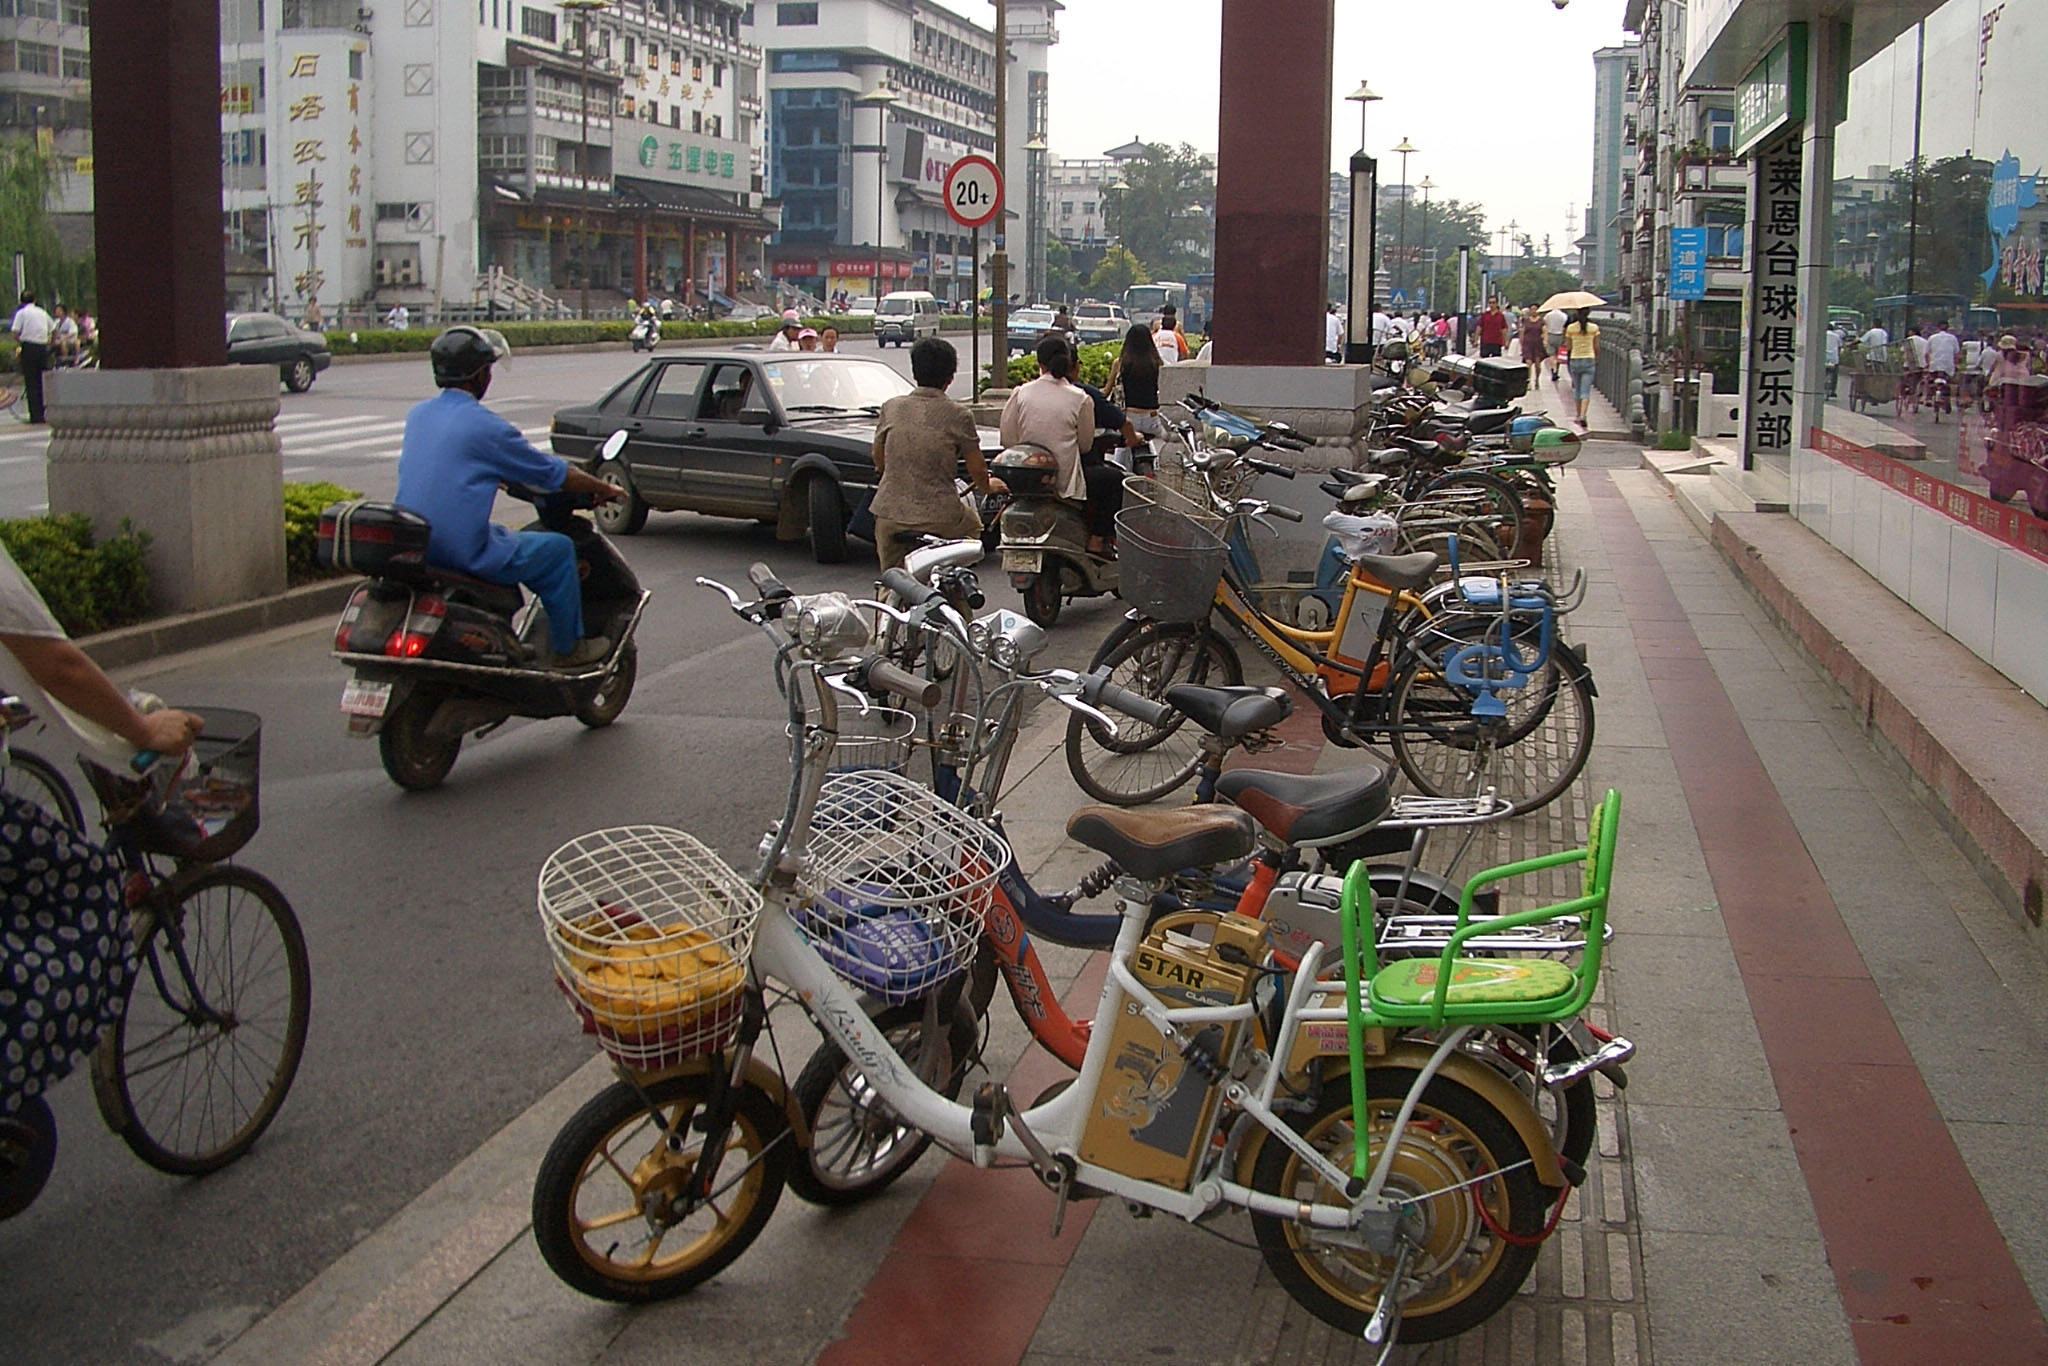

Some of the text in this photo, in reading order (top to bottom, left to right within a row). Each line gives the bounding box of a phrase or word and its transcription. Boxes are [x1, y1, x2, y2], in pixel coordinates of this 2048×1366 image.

[667, 142, 735, 178] 五星电器
[1679, 233, 1699, 285] 二道河
[1137, 952, 1205, 989] STAR
